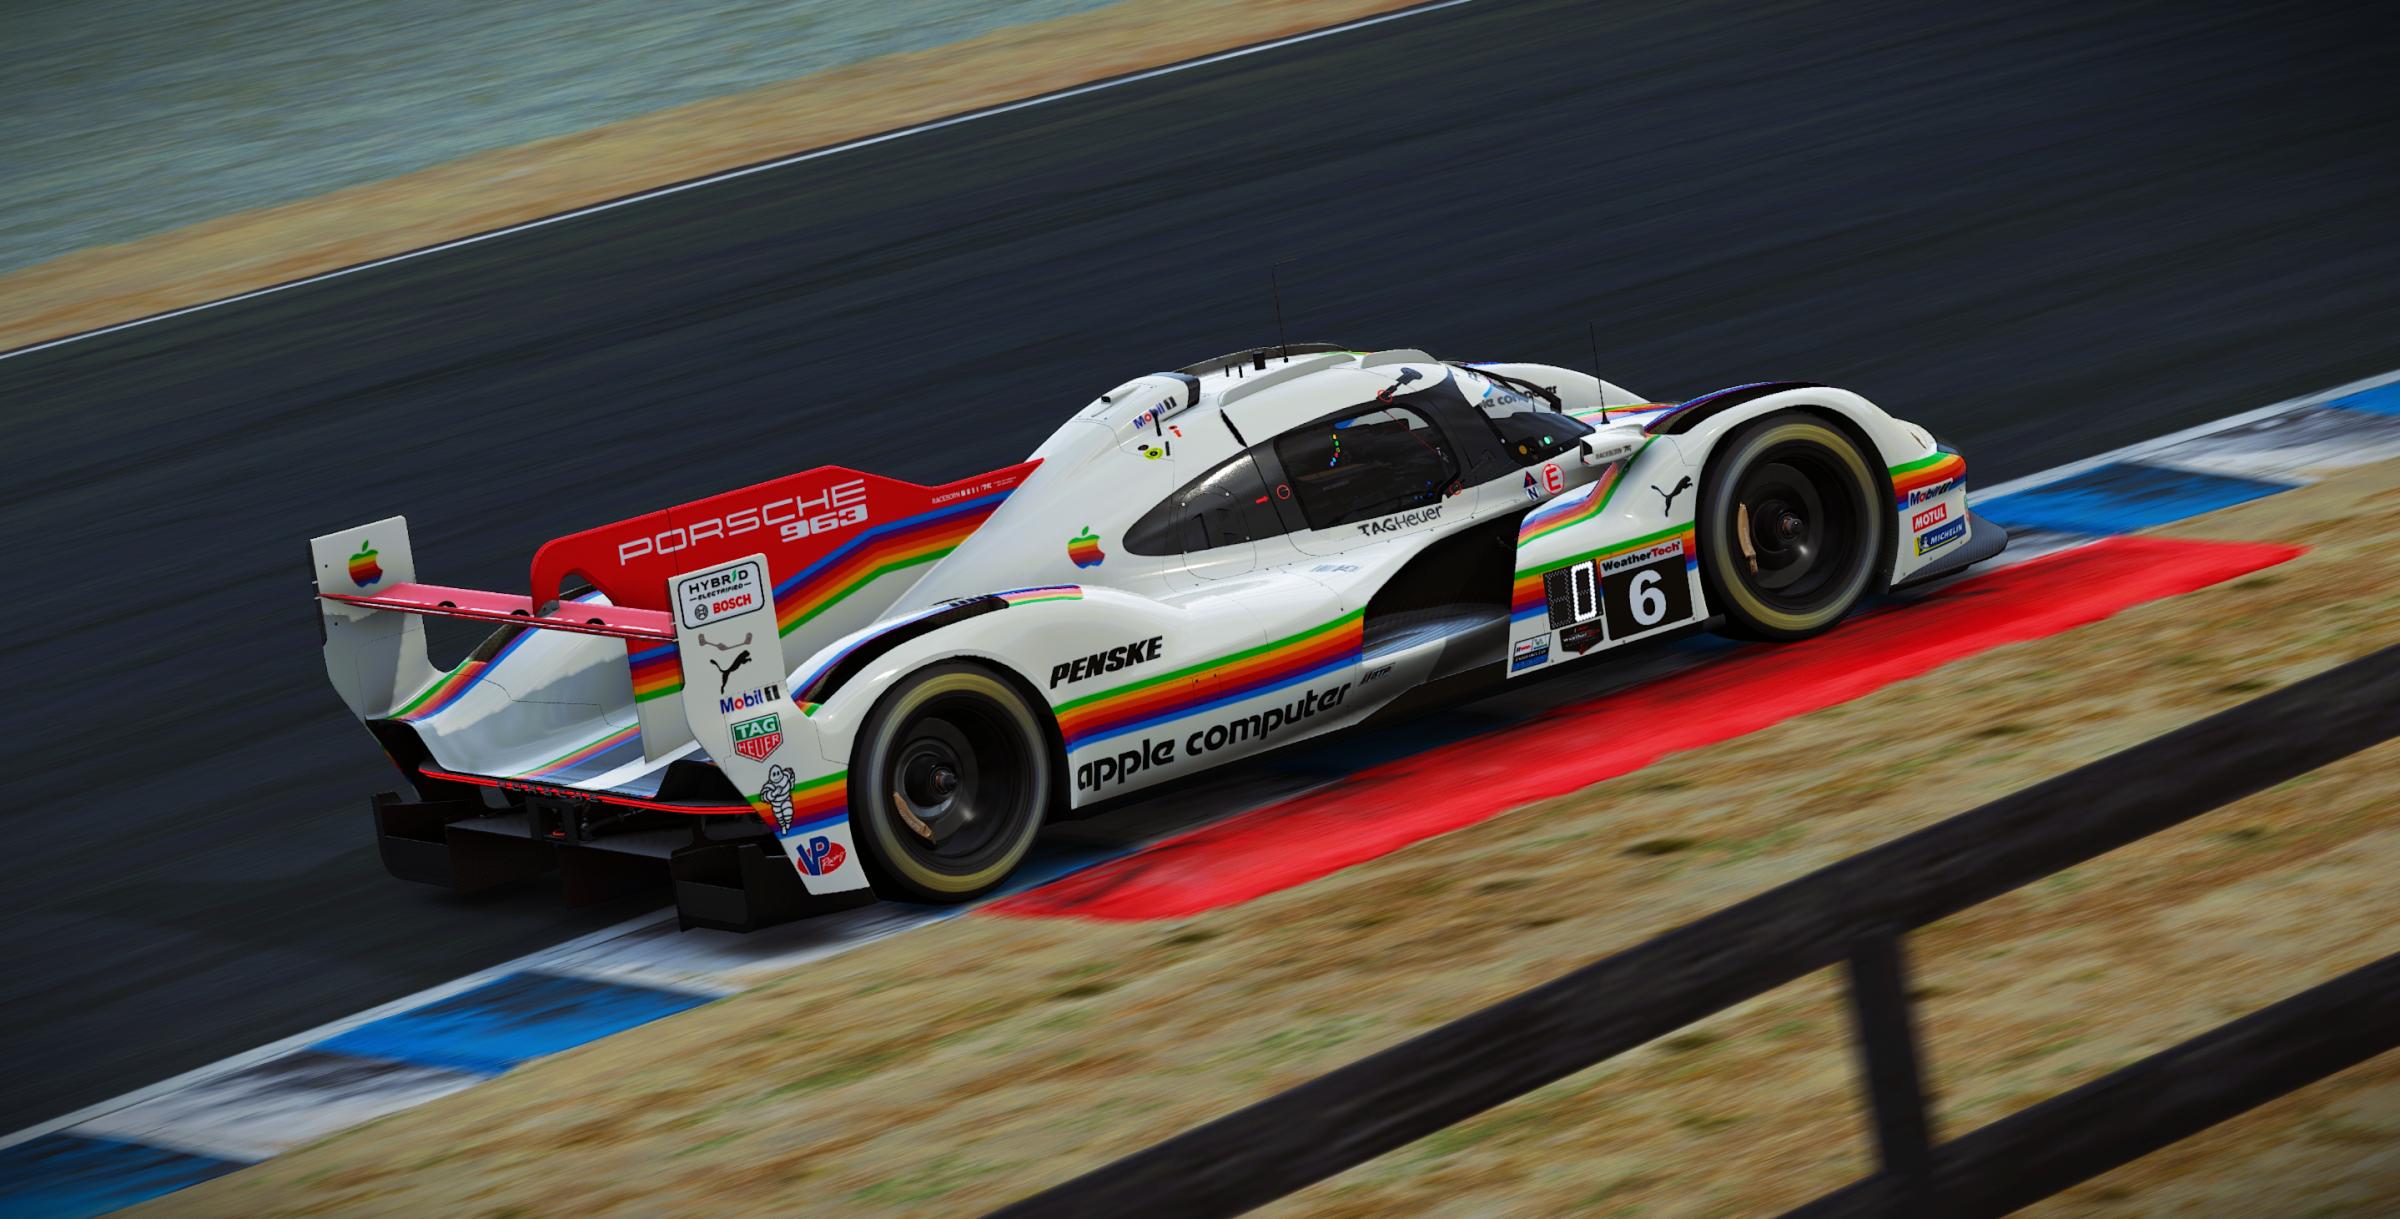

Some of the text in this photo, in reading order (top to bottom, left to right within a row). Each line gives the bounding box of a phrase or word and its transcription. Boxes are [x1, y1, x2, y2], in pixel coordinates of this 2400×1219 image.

[1545, 467, 1561, 492] E
[1528, 487, 1539, 500] N
[618, 478, 867, 566] PORSCHE
[779, 503, 869, 543] 963
[1914, 506, 1946, 529] MOTUL
[1930, 523, 1963, 545] MICHELIN
[1602, 541, 1681, 571] WeatherTech
[697, 583, 744, 601] ELECTRIFIED
[712, 593, 753, 615] BOSCH
[1629, 569, 1667, 626] 6
[1050, 635, 1163, 689] PENSKE
[720, 685, 780, 714] Mobil 1
[735, 716, 777, 740] TAG
[1077, 682, 1352, 792] apple computer
[737, 732, 781, 758] HEUER
[796, 835, 831, 876] VP
